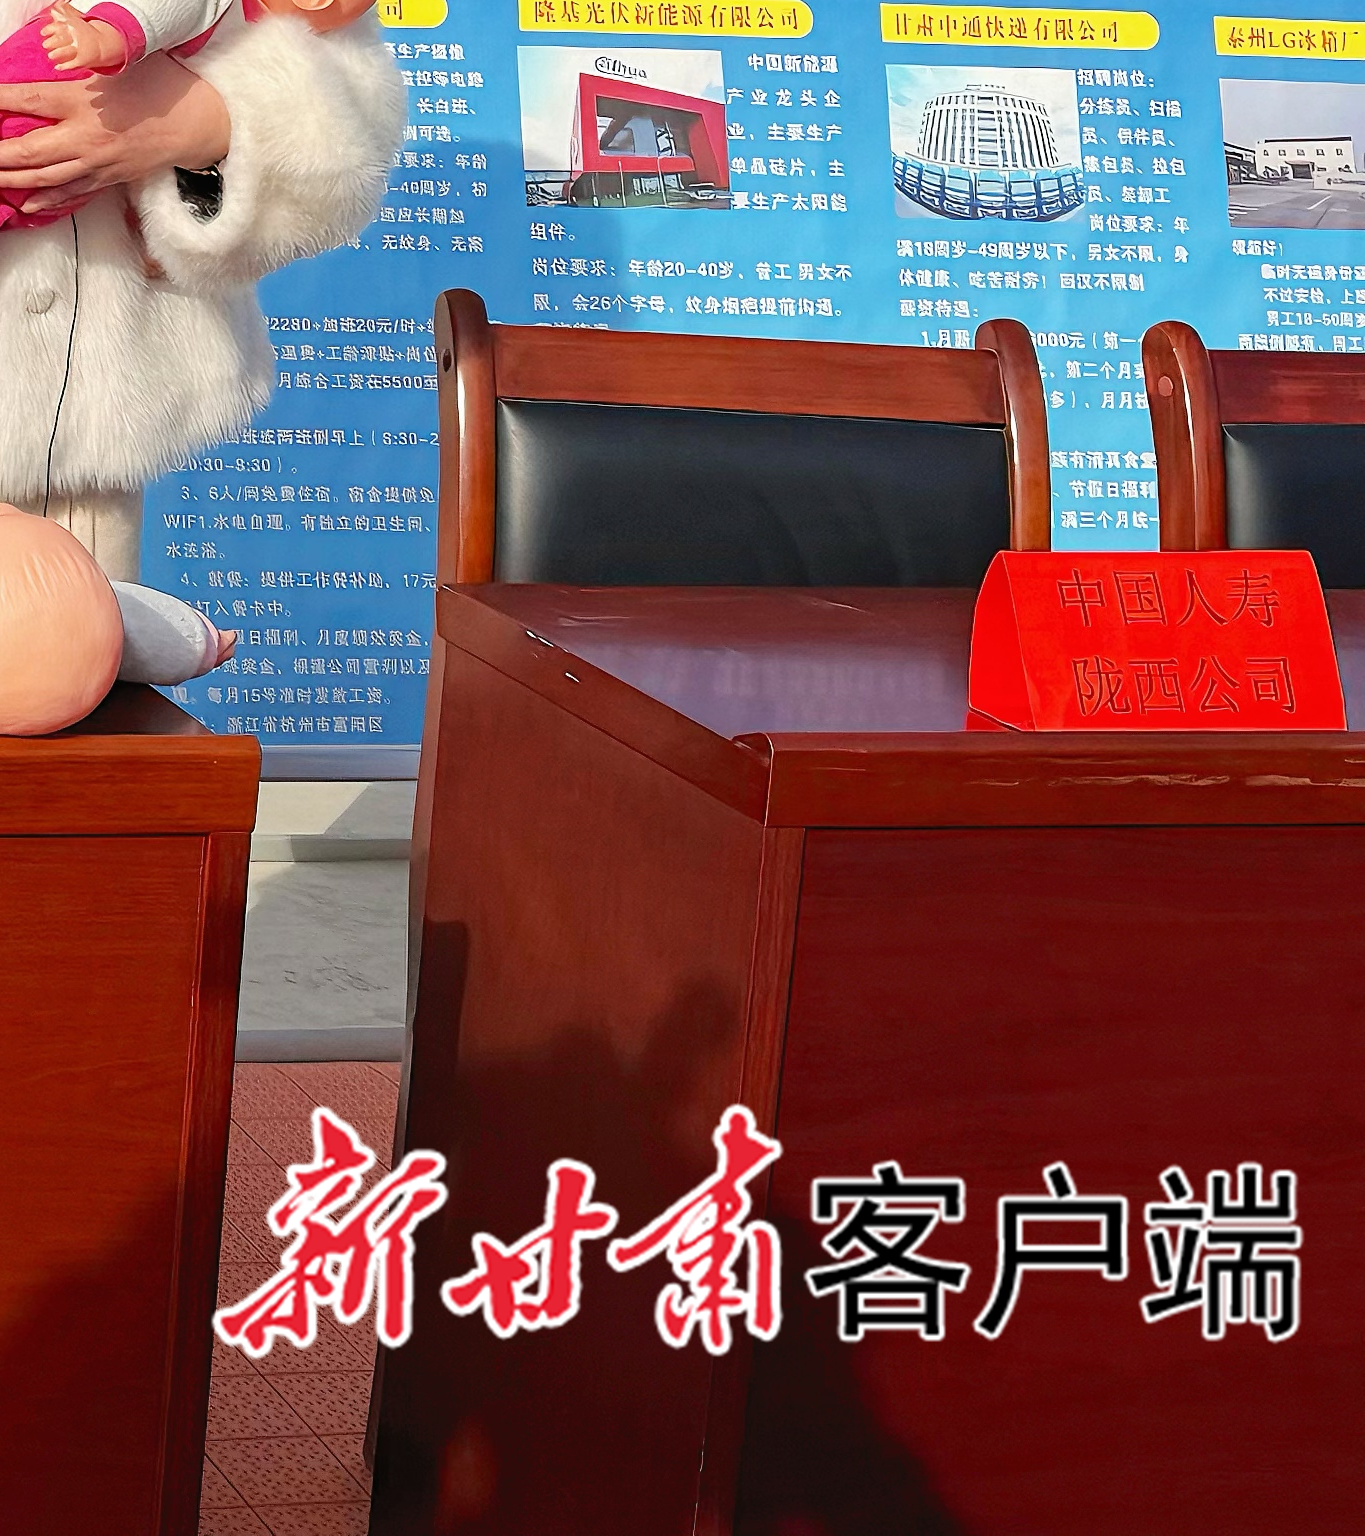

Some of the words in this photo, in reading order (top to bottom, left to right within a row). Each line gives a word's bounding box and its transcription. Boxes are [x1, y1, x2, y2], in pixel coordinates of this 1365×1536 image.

[533, 0, 799, 31] 隆基光伏新能源有限公司
[894, 11, 1119, 44] 甘肃中通快递有限公司
[748, 53, 839, 74] 中国新能源
[1055, 567, 1282, 629] 中国人寿
[1071, 654, 1297, 716] 陇西公司
